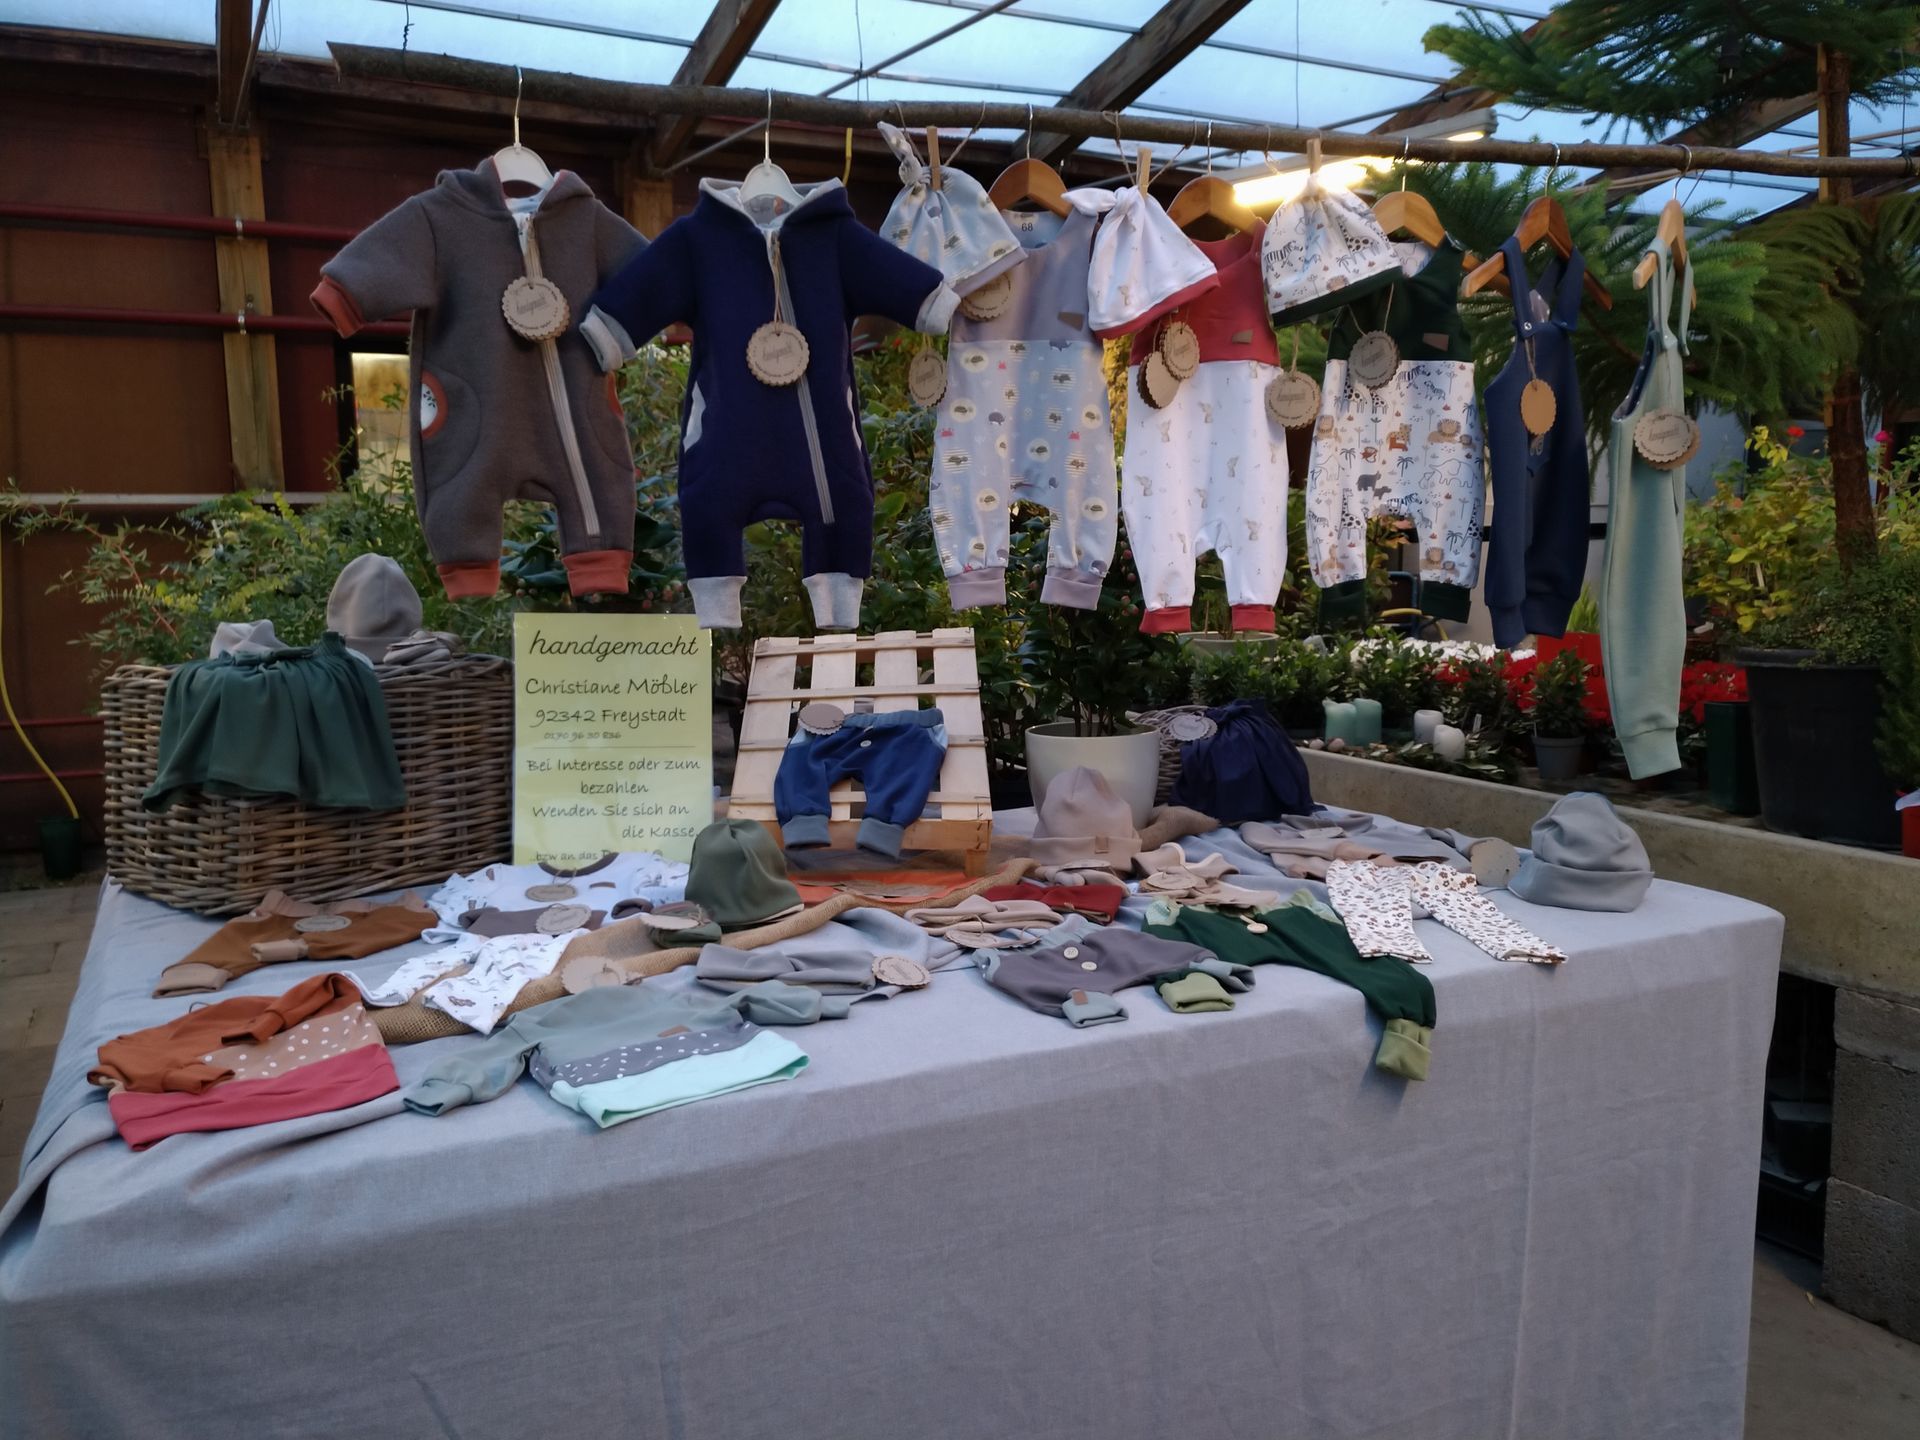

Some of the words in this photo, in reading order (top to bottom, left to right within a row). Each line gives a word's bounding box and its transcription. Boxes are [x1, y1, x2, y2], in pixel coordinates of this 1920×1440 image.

[1021, 222, 1033, 232] 68
[529, 630, 699, 663] handgemacht
[525, 678, 621, 695] Christiane
[627, 674, 698, 695] Mößler
[529, 709, 597, 728] 92342
[601, 707, 688, 730] Freystadt
[527, 759, 551, 772] Bei
[557, 759, 625, 772] Interesse
[628, 757, 660, 771] oder
[664, 759, 701, 770] zum
[580, 781, 649, 795] bezahlen
[602, 803, 629, 817] Sie
[633, 803, 663, 817] sich
[668, 805, 690, 815] an
[622, 826, 645, 839] die
[560, 853, 576, 861] an
[578, 851, 598, 861] das
